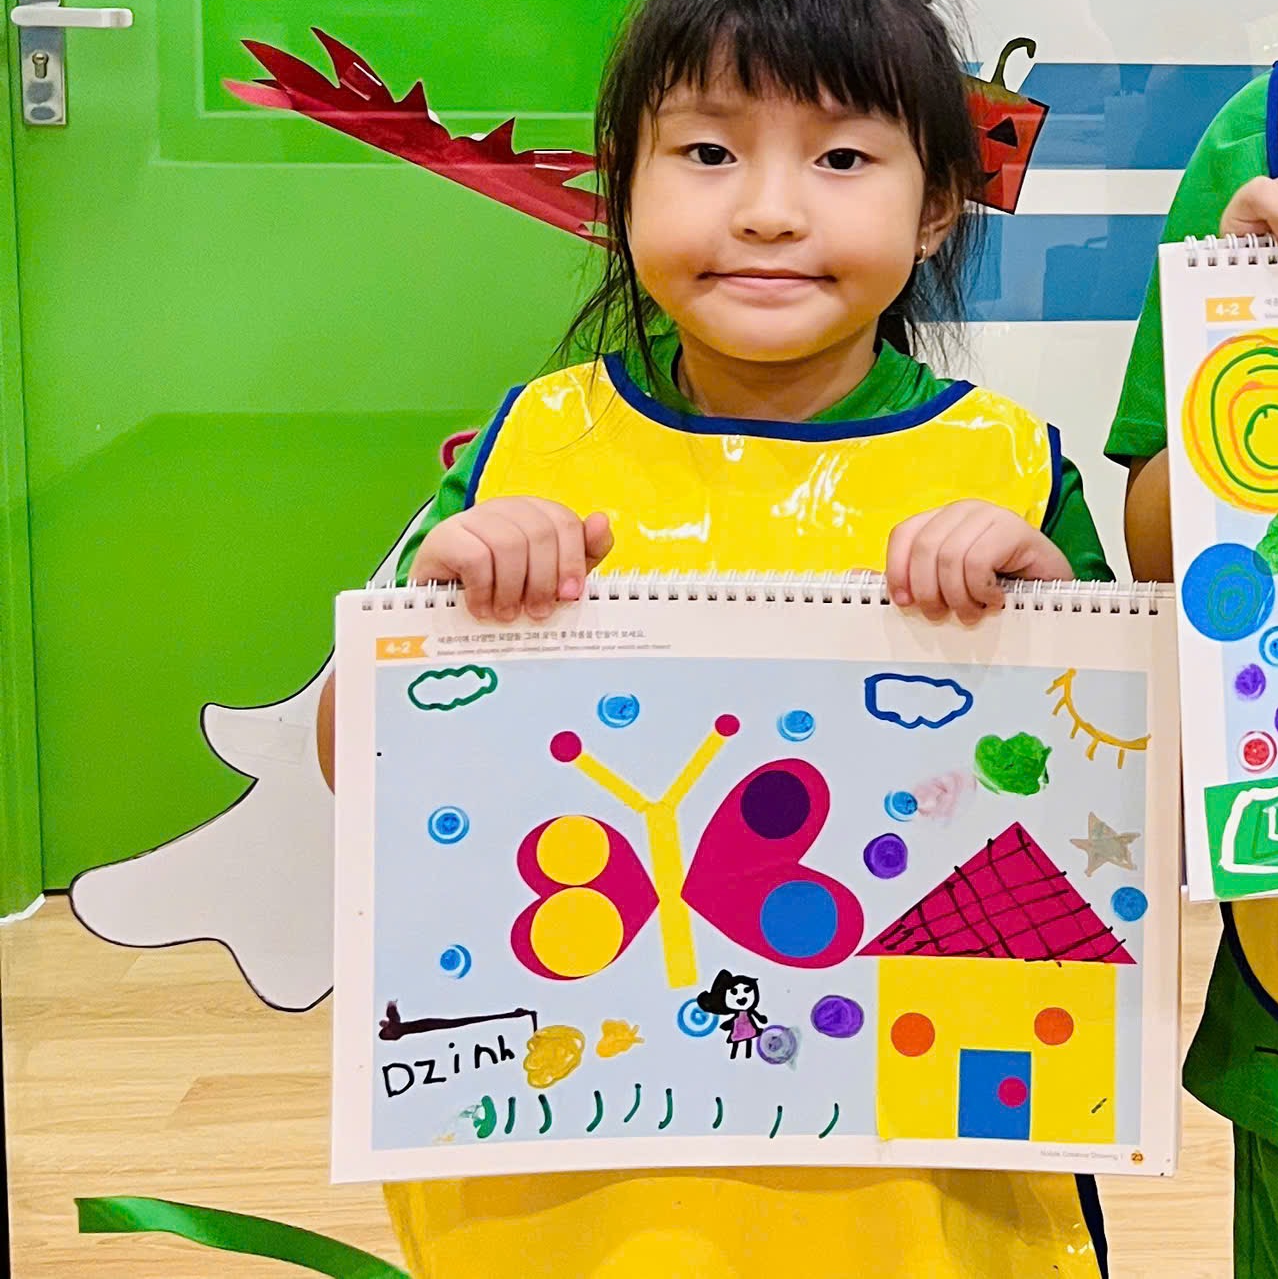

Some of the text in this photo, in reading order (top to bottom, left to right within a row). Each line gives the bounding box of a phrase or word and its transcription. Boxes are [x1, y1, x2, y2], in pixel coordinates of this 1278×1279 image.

[1215, 302, 1240, 316] 4-2
[384, 640, 411, 655] 4-2
[1131, 1152, 1144, 1162] 23
